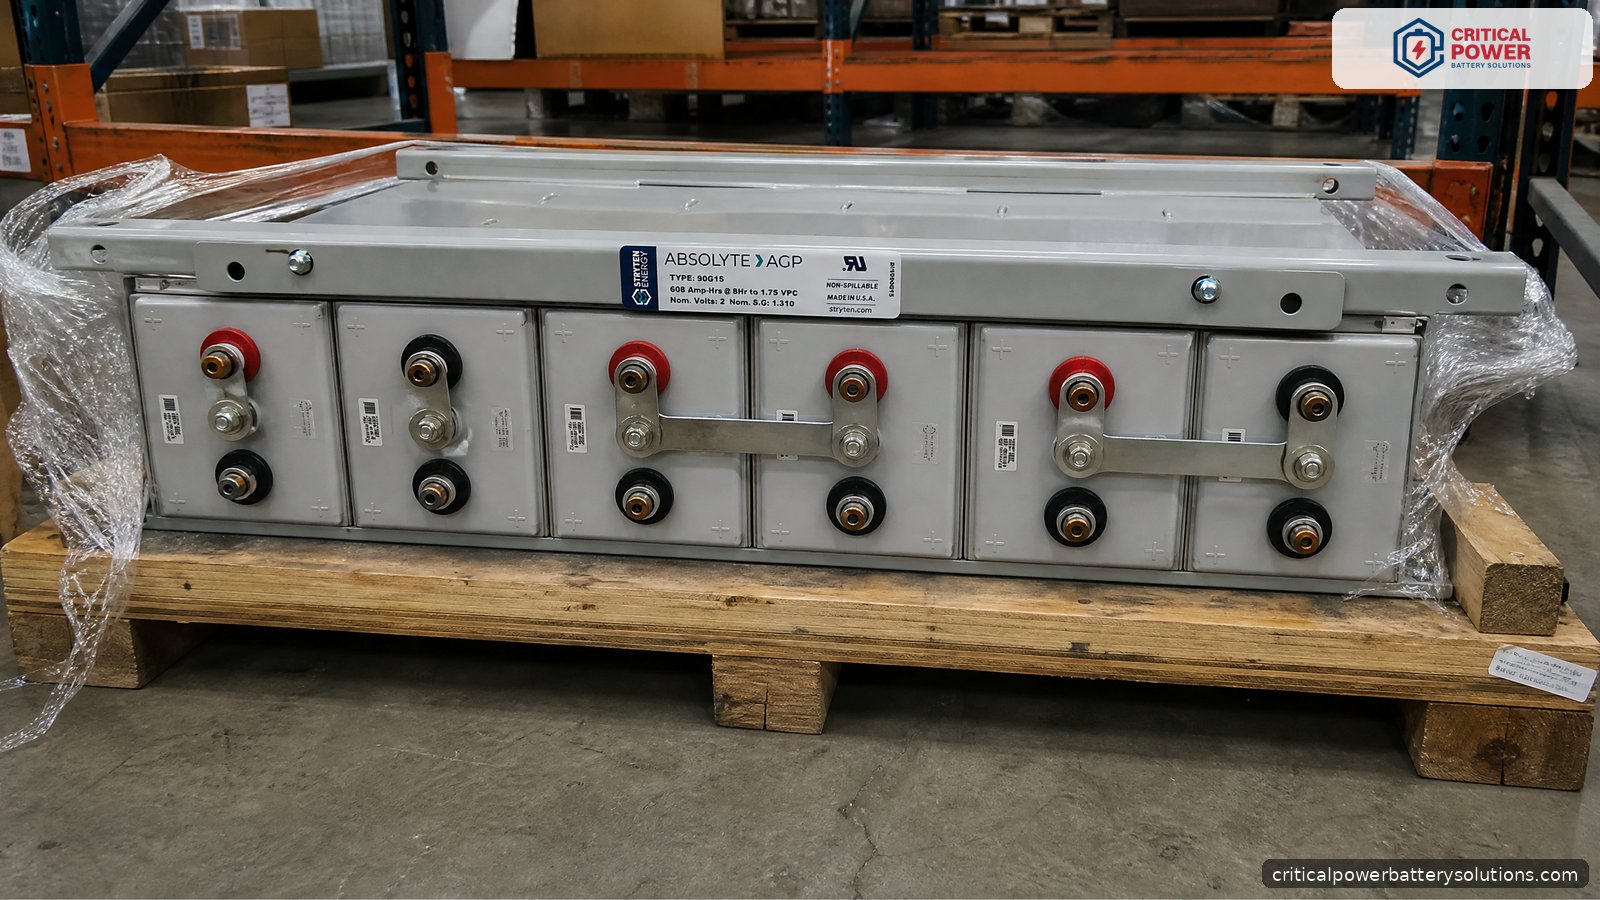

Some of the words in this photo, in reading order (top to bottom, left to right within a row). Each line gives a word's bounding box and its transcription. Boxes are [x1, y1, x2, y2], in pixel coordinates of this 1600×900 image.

[664, 252, 751, 268] ABSOLYTE
[766, 254, 803, 269] AGP
[632, 250, 641, 287] STRYTEN
[640, 250, 649, 288] ENERGY
[669, 274, 695, 282] TYPE:
[696, 275, 725, 283] 90G15
[826, 282, 879, 290] NON-SPILLABLE
[669, 286, 686, 294] 608
[688, 286, 723, 295] Amp-Hrs
[724, 287, 732, 296] @
[732, 287, 748, 296] 8Hr
[749, 288, 759, 297] to
[760, 289, 779, 297] 1.75
[780, 289, 799, 297] VPC
[694, 297, 718, 305] Volts:
[719, 298, 726, 306] 2
[729, 298, 751, 306] Nom.
[752, 299, 770, 307] S.G:
[772, 299, 795, 307] 1.310
[829, 306, 872, 314] stryten.com
